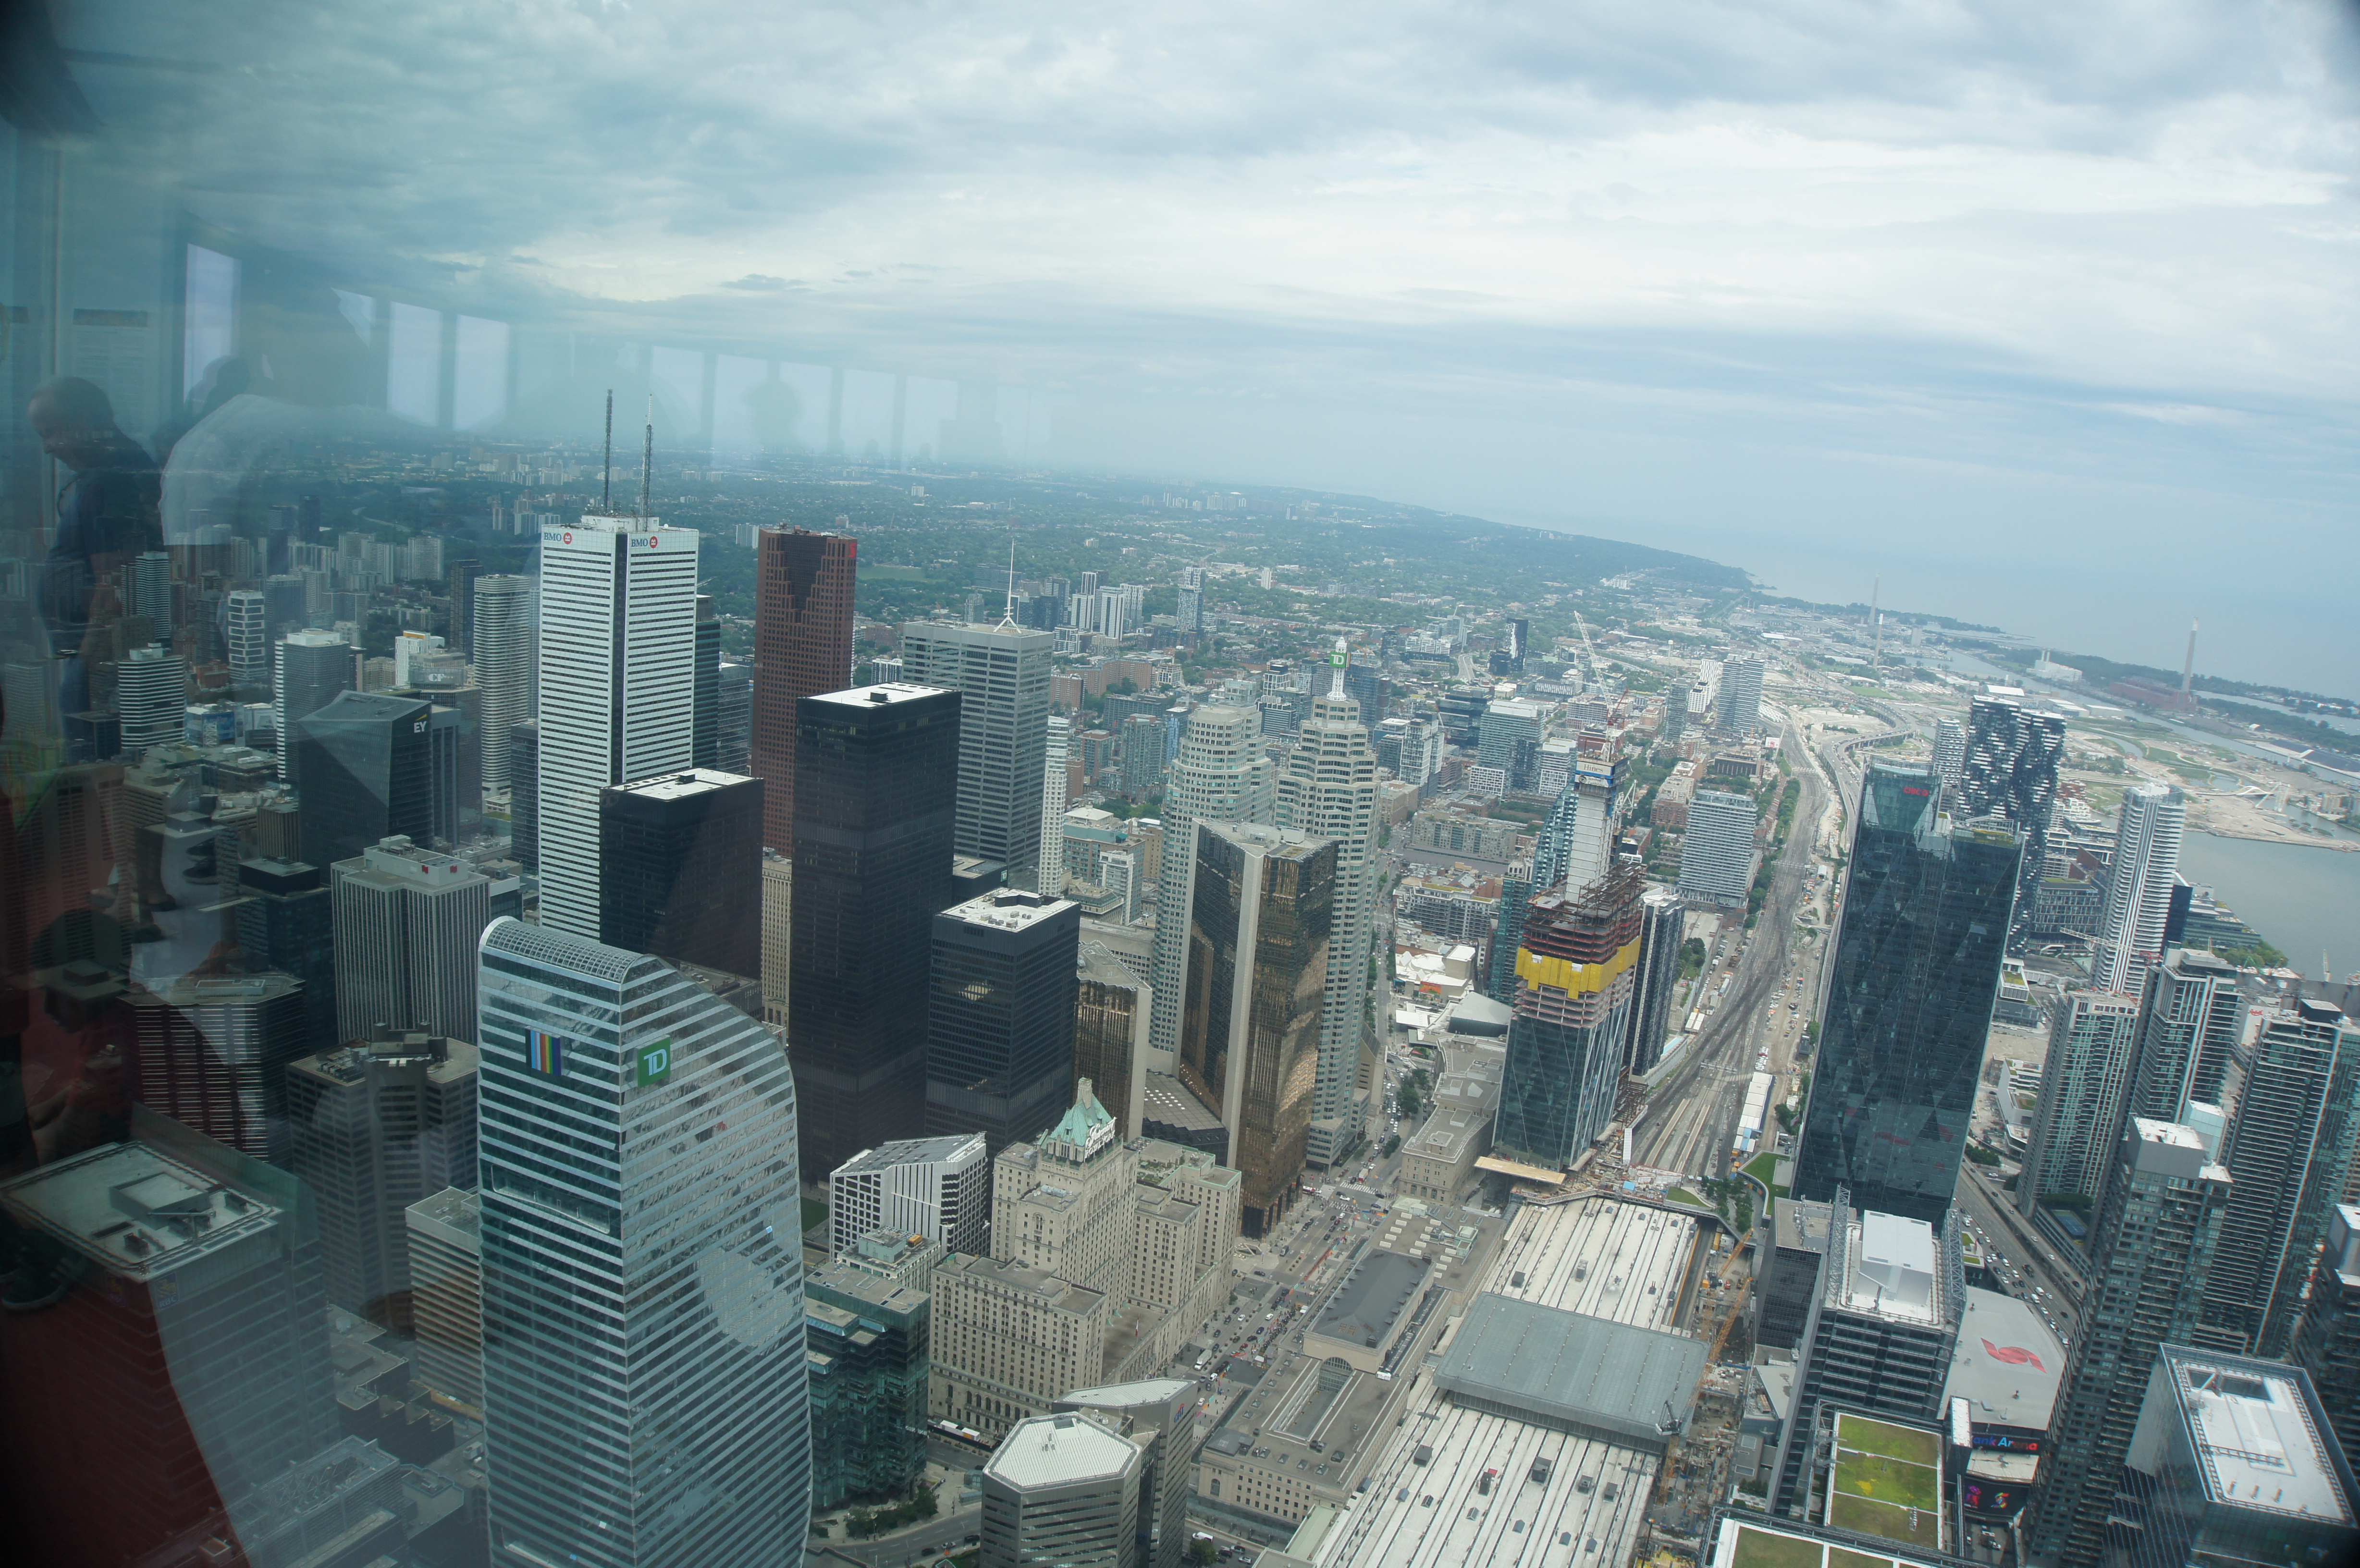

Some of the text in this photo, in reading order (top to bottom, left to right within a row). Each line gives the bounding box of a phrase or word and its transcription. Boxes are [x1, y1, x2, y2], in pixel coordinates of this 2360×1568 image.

[544, 532, 561, 541] BMO
[631, 538, 648, 547] BMO
[1331, 654, 1344, 665] TD
[428, 674, 444, 682] CF
[414, 721, 427, 733] EY
[1584, 764, 1603, 773] Hines
[1904, 786, 1921, 796] CIBC
[643, 1049, 667, 1076] TD
[159, 1295, 177, 1308] RBC
[1174, 1403, 1185, 1423] citi
[1972, 1436, 1997, 1446] ank
